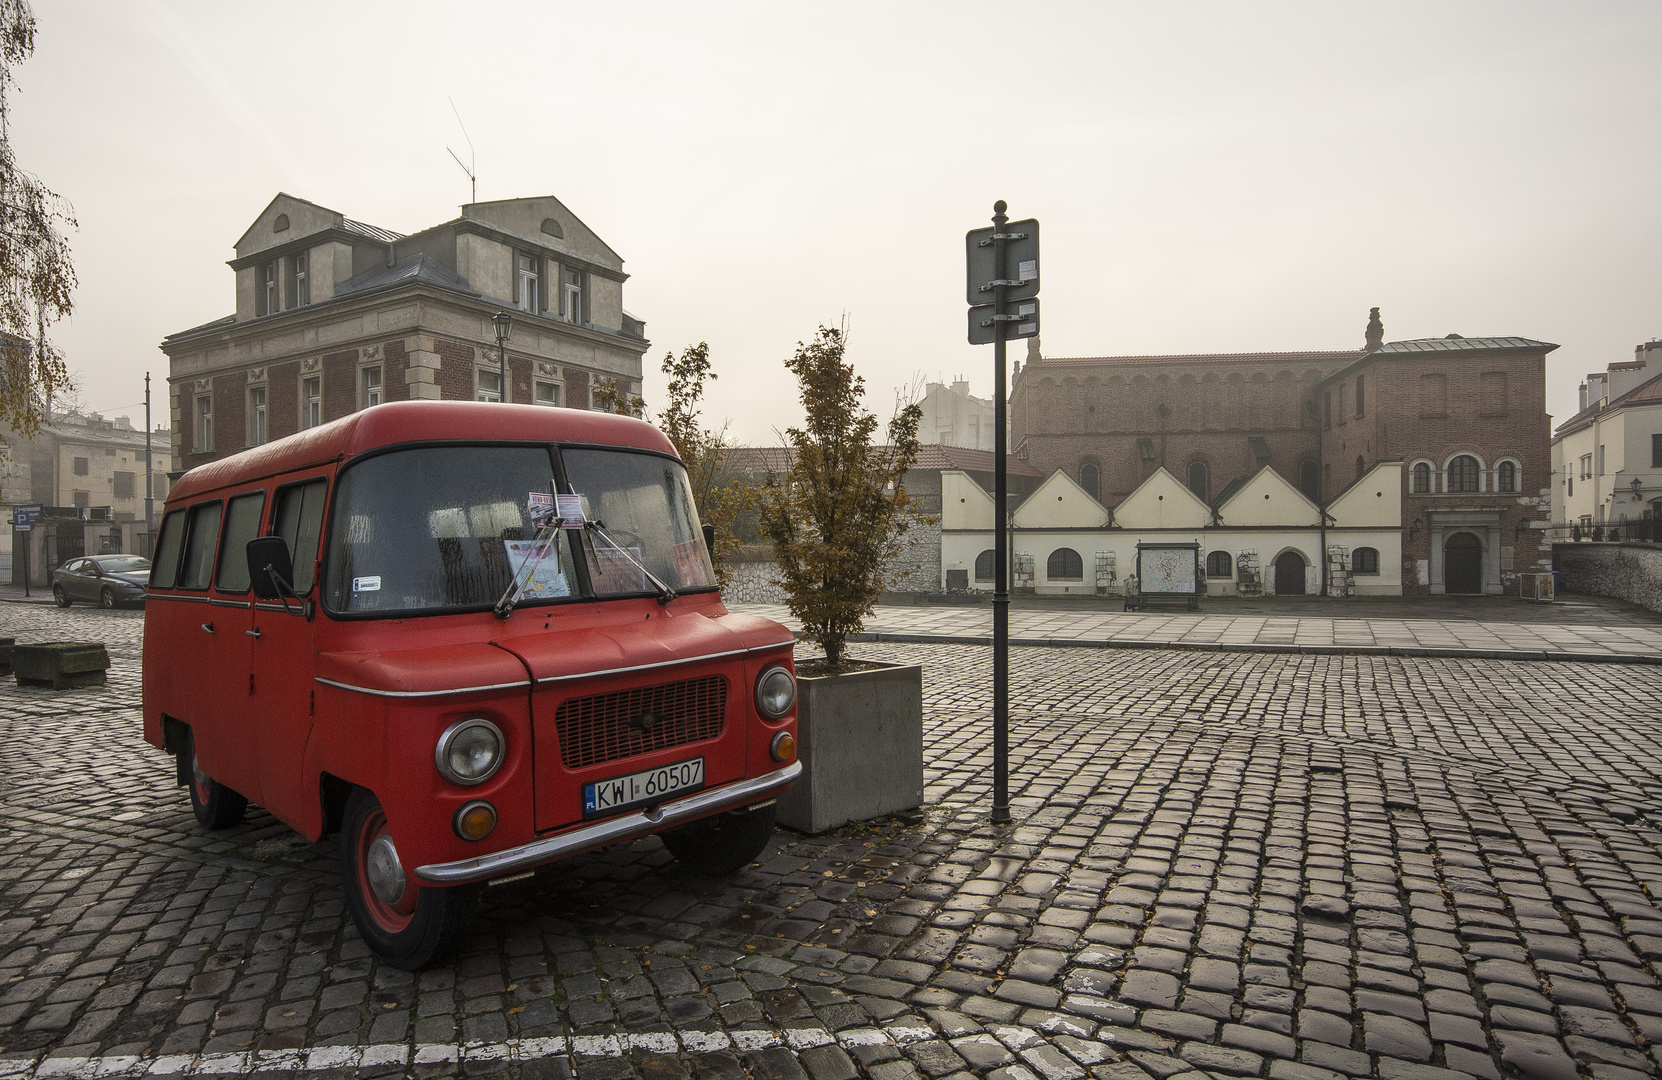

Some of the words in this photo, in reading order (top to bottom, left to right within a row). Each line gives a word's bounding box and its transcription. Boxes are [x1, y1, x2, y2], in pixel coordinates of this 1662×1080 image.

[18, 514, 27, 524] P
[598, 777, 634, 808] KWI
[645, 761, 701, 795] 60507
